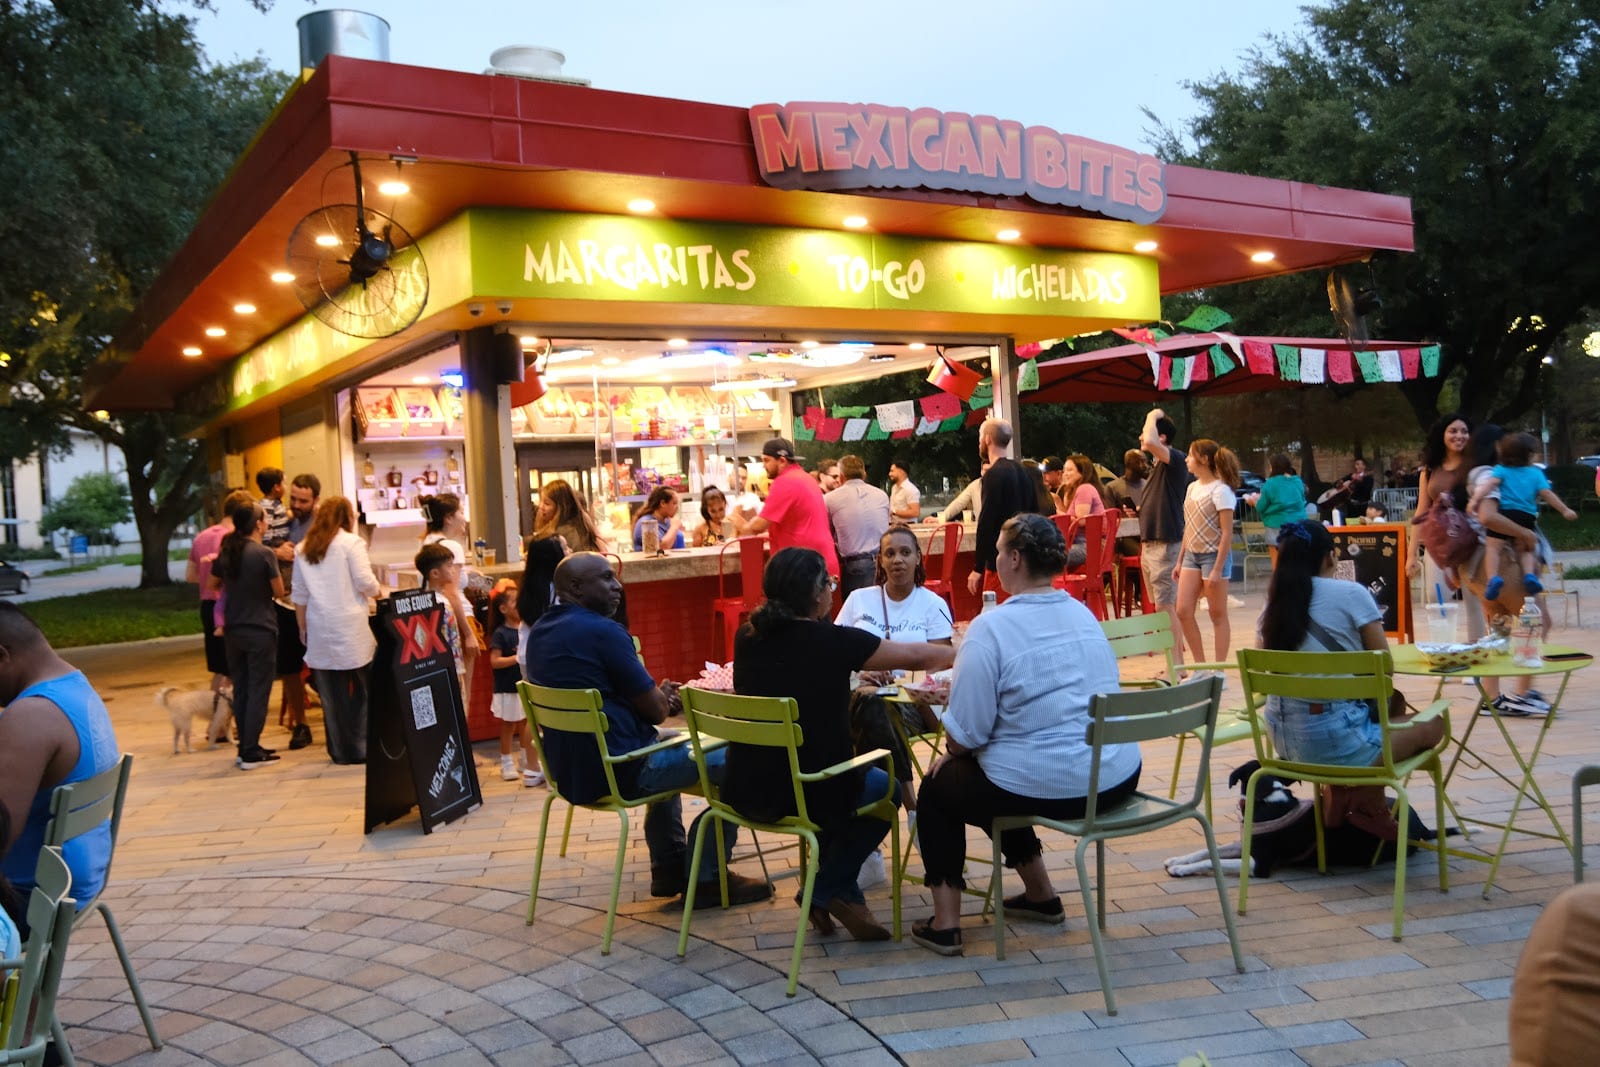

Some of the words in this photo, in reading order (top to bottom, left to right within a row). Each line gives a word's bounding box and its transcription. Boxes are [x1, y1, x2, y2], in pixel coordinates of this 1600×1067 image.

[756, 111, 1022, 180] MEXICAN
[1033, 134, 1164, 213] BITES
[523, 240, 756, 291] MARGARITAS
[827, 255, 926, 300] TO-GO
[992, 263, 1127, 304] MICHELADAS
[395, 597, 412, 614] DOS
[410, 593, 433, 611] EQUIS
[392, 610, 447, 665] XX
[429, 734, 457, 798] WELCOME!
